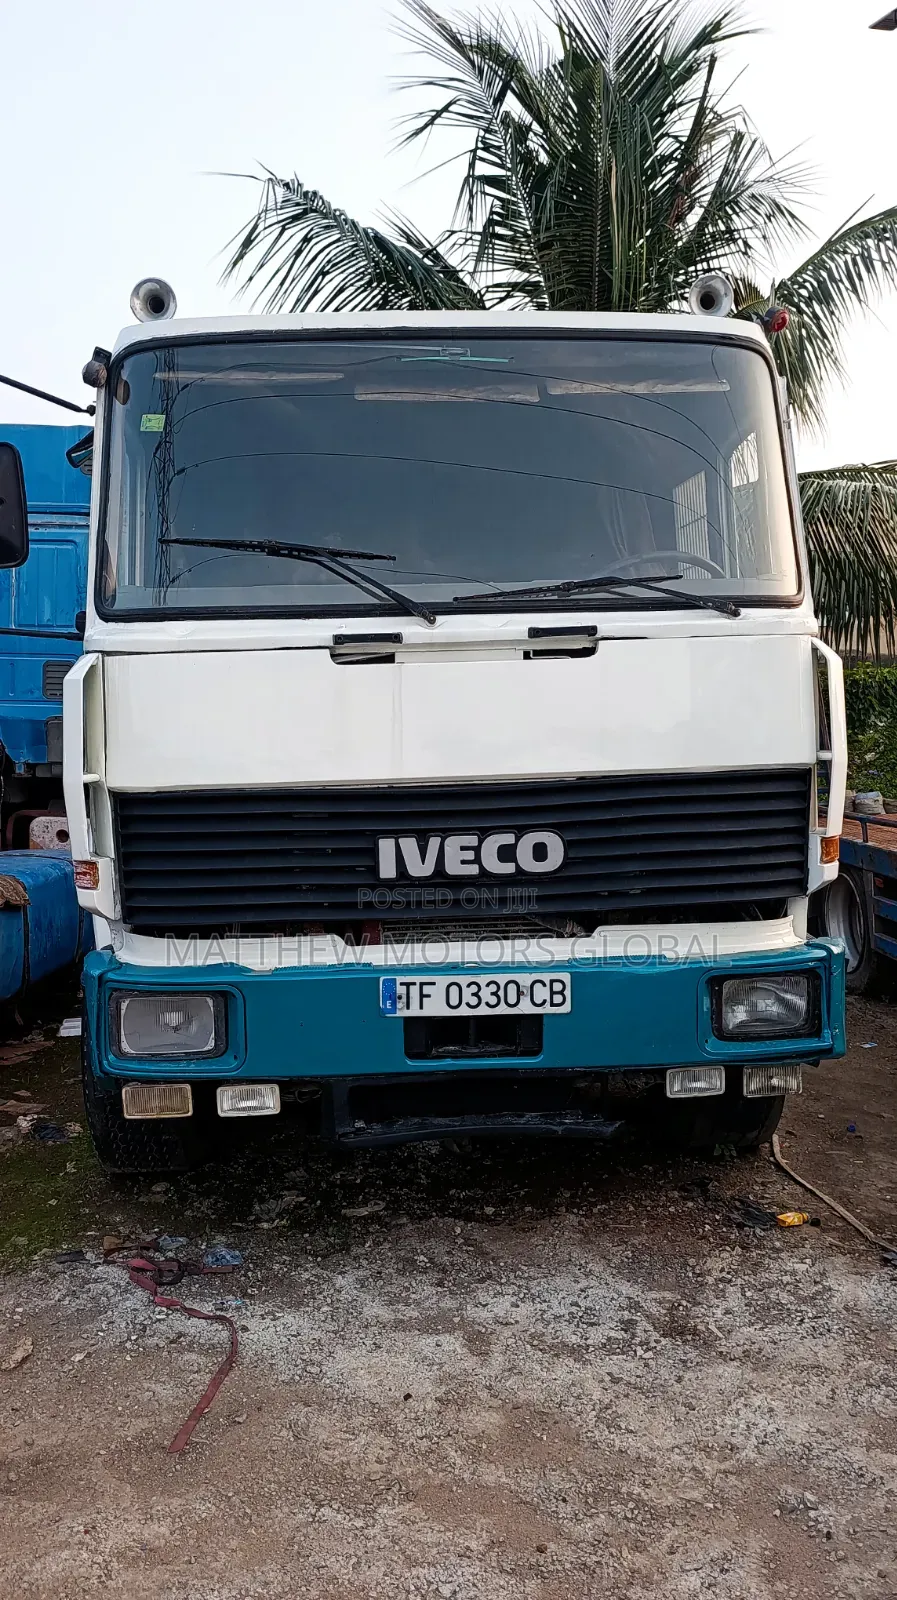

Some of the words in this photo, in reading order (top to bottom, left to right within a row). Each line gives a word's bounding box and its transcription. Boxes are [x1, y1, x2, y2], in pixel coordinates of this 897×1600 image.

[378, 831, 565, 879] IVECO
[399, 981, 436, 1010] TF
[445, 979, 521, 1010] 0330
[529, 979, 567, 1008] CB
